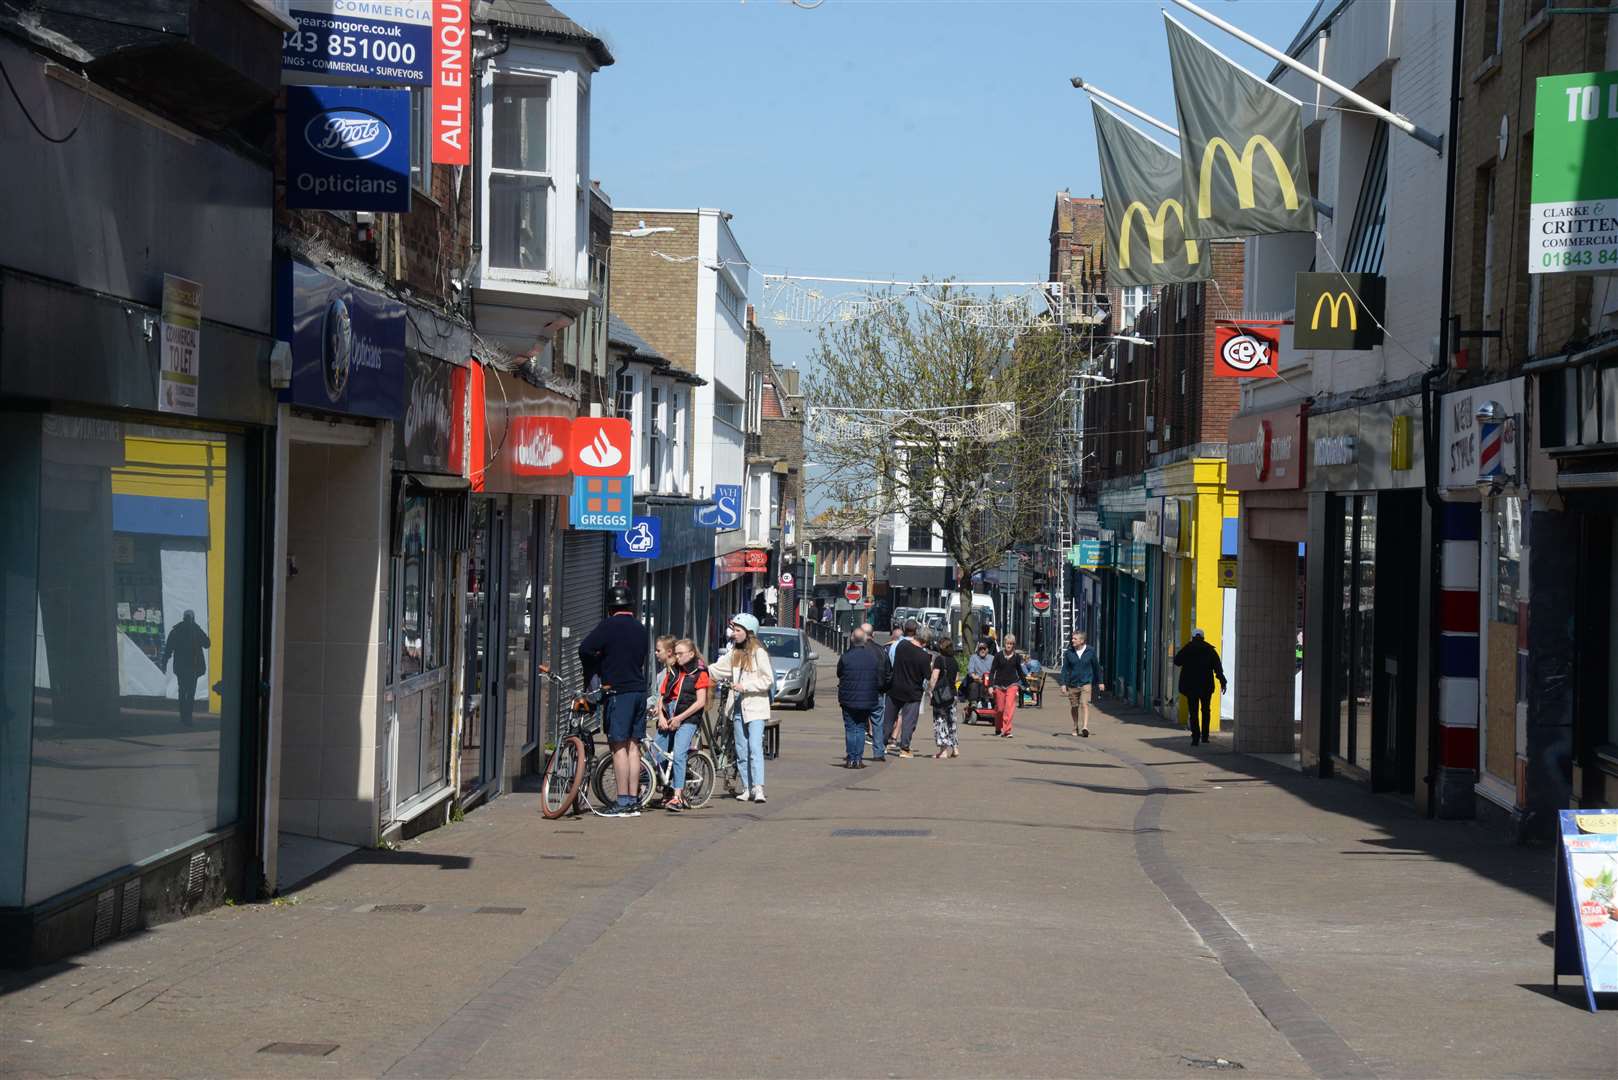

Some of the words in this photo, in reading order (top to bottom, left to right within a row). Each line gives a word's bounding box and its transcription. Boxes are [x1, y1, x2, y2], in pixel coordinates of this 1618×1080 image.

[327, 35, 416, 65] 851000
[441, 0, 466, 87] ENQU
[312, 58, 369, 75] COMMERCIAL
[376, 65, 424, 80] SURVEYORS
[1566, 85, 1600, 122] TO
[317, 117, 381, 150] Boots
[441, 97, 462, 150] ALL
[297, 172, 398, 197] Opticians
[1543, 206, 1590, 218] CLARKE
[1593, 202, 1605, 216] &
[1542, 251, 1593, 267] 01843
[169, 345, 180, 371] TO
[180, 347, 193, 375] LET
[719, 488, 737, 497] WH
[581, 514, 627, 526] GREGGS
[717, 496, 737, 526] S
